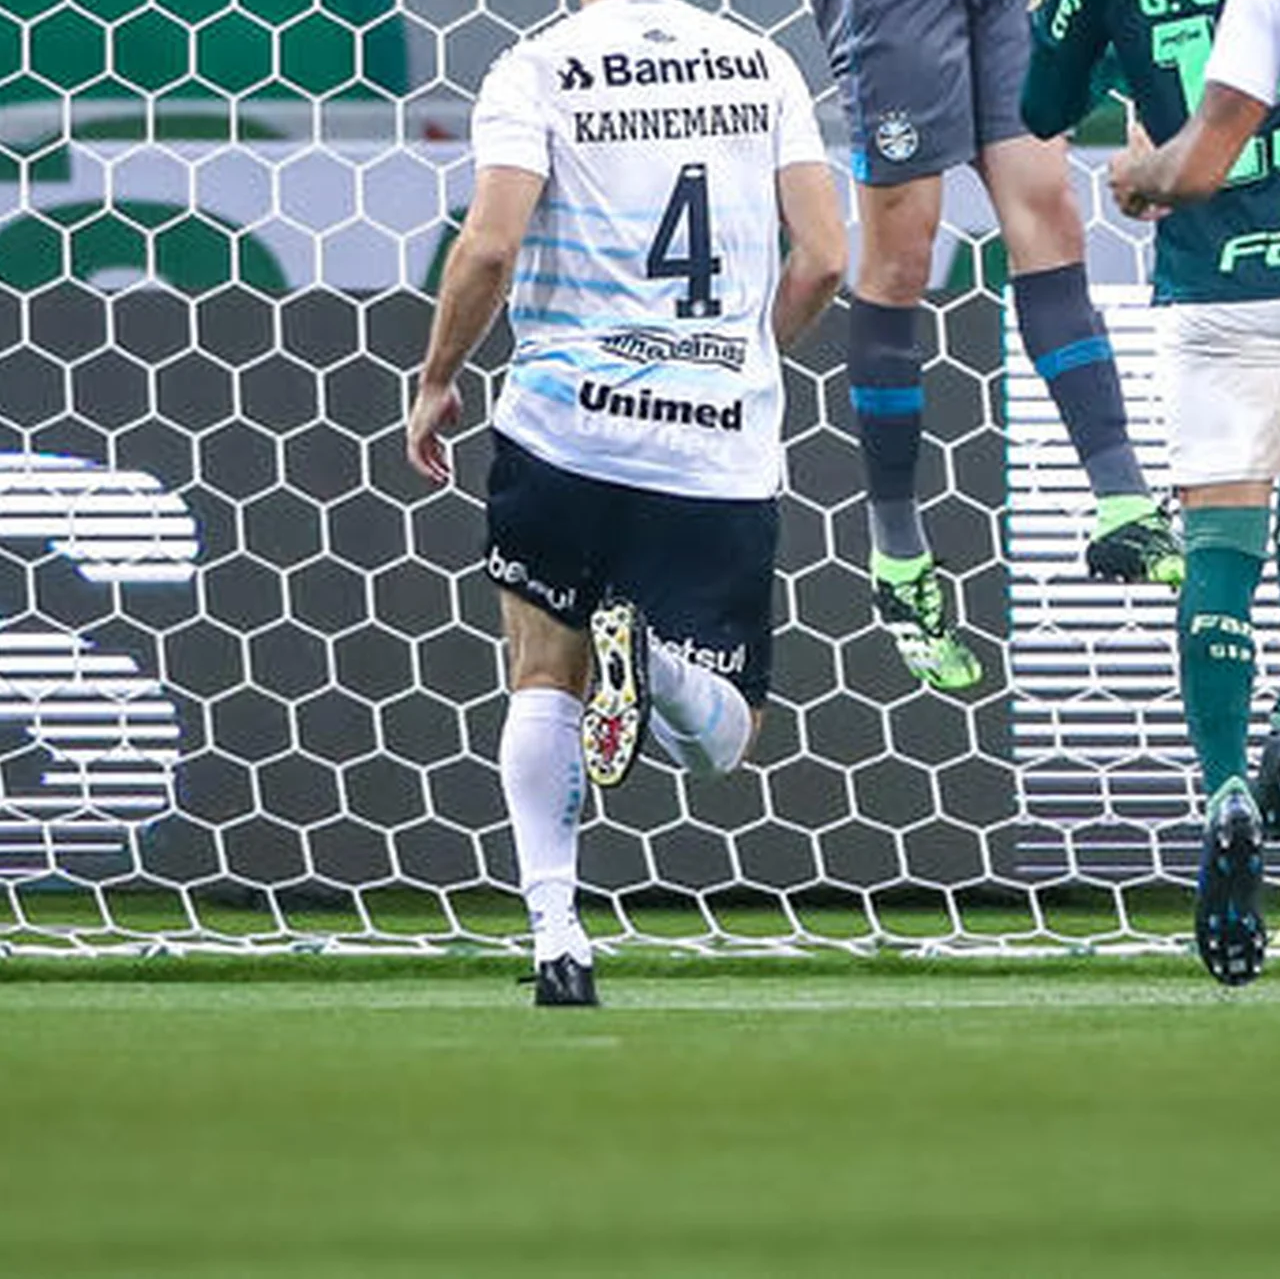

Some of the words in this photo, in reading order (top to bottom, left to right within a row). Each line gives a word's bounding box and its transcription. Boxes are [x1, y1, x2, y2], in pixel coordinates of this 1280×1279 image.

[601, 49, 770, 89] Banrisul
[574, 103, 771, 144] KANNEMANN
[646, 163, 721, 319] 4
[579, 380, 743, 432] Unimed
